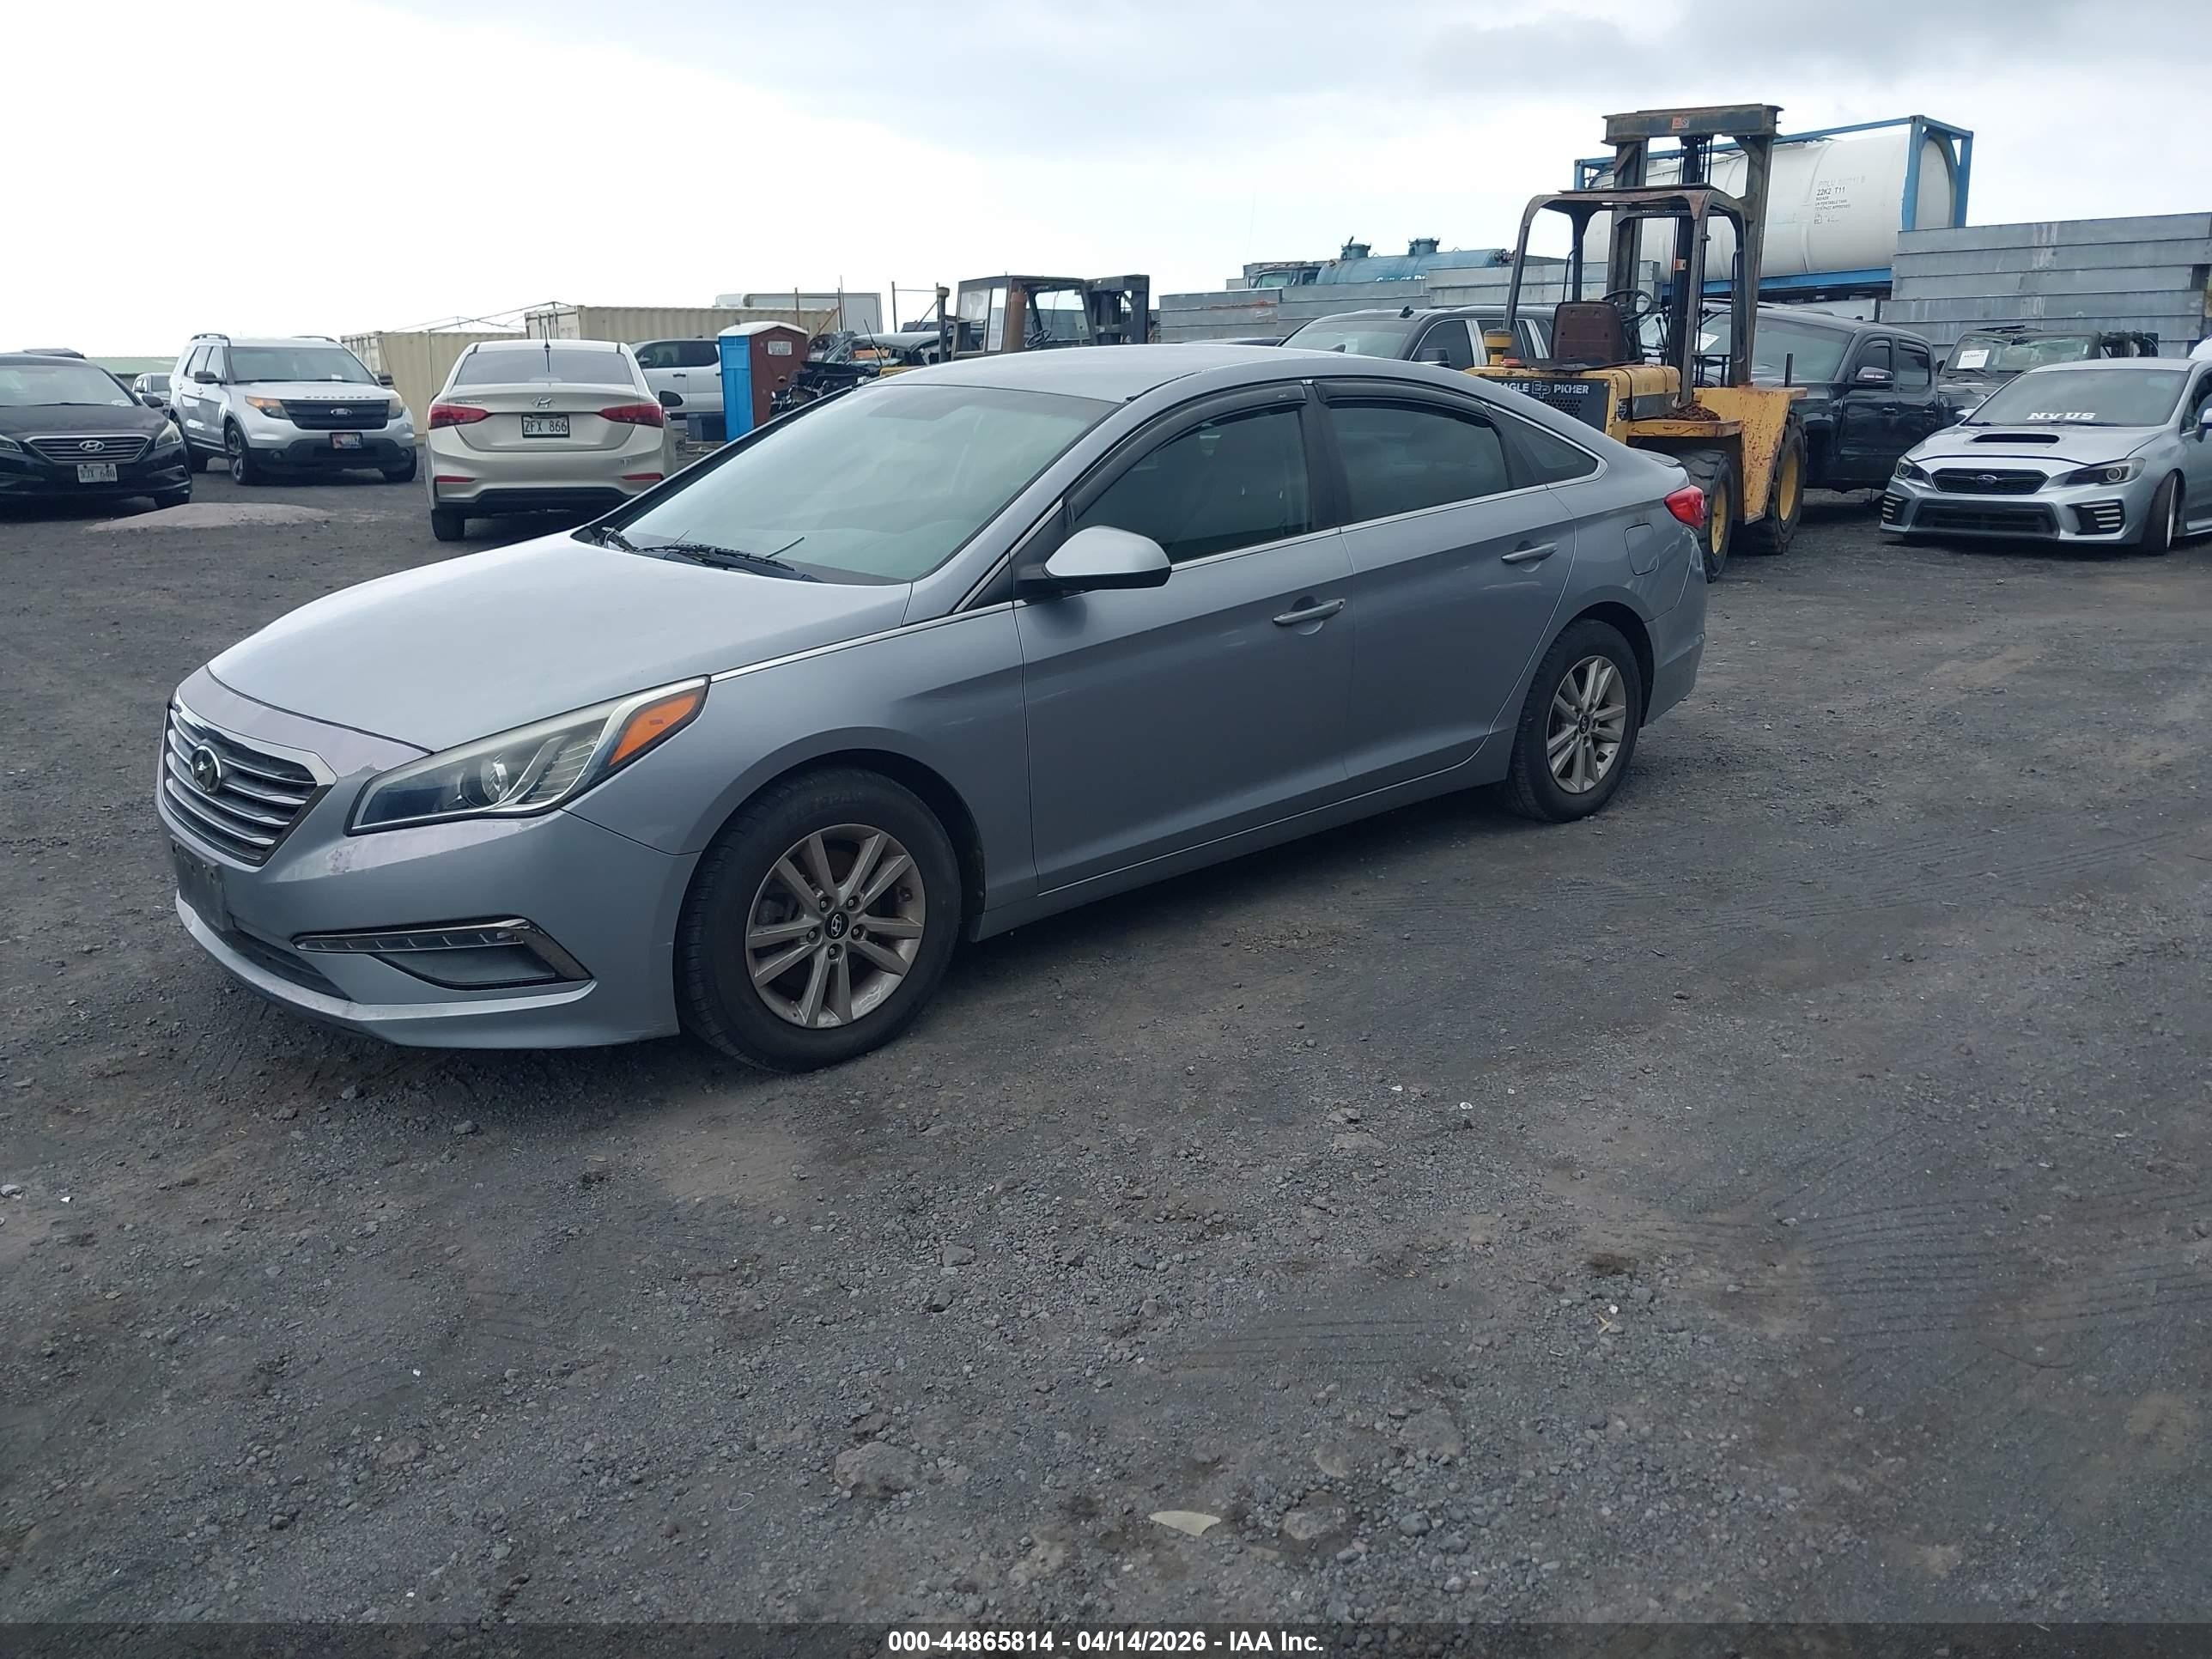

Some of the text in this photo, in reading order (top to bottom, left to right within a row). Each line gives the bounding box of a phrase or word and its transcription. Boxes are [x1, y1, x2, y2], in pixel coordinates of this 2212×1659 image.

[1816, 187, 1832, 196] 22K2
[1553, 383, 1589, 394] PICHER
[524, 419, 568, 433] ZFX 866
